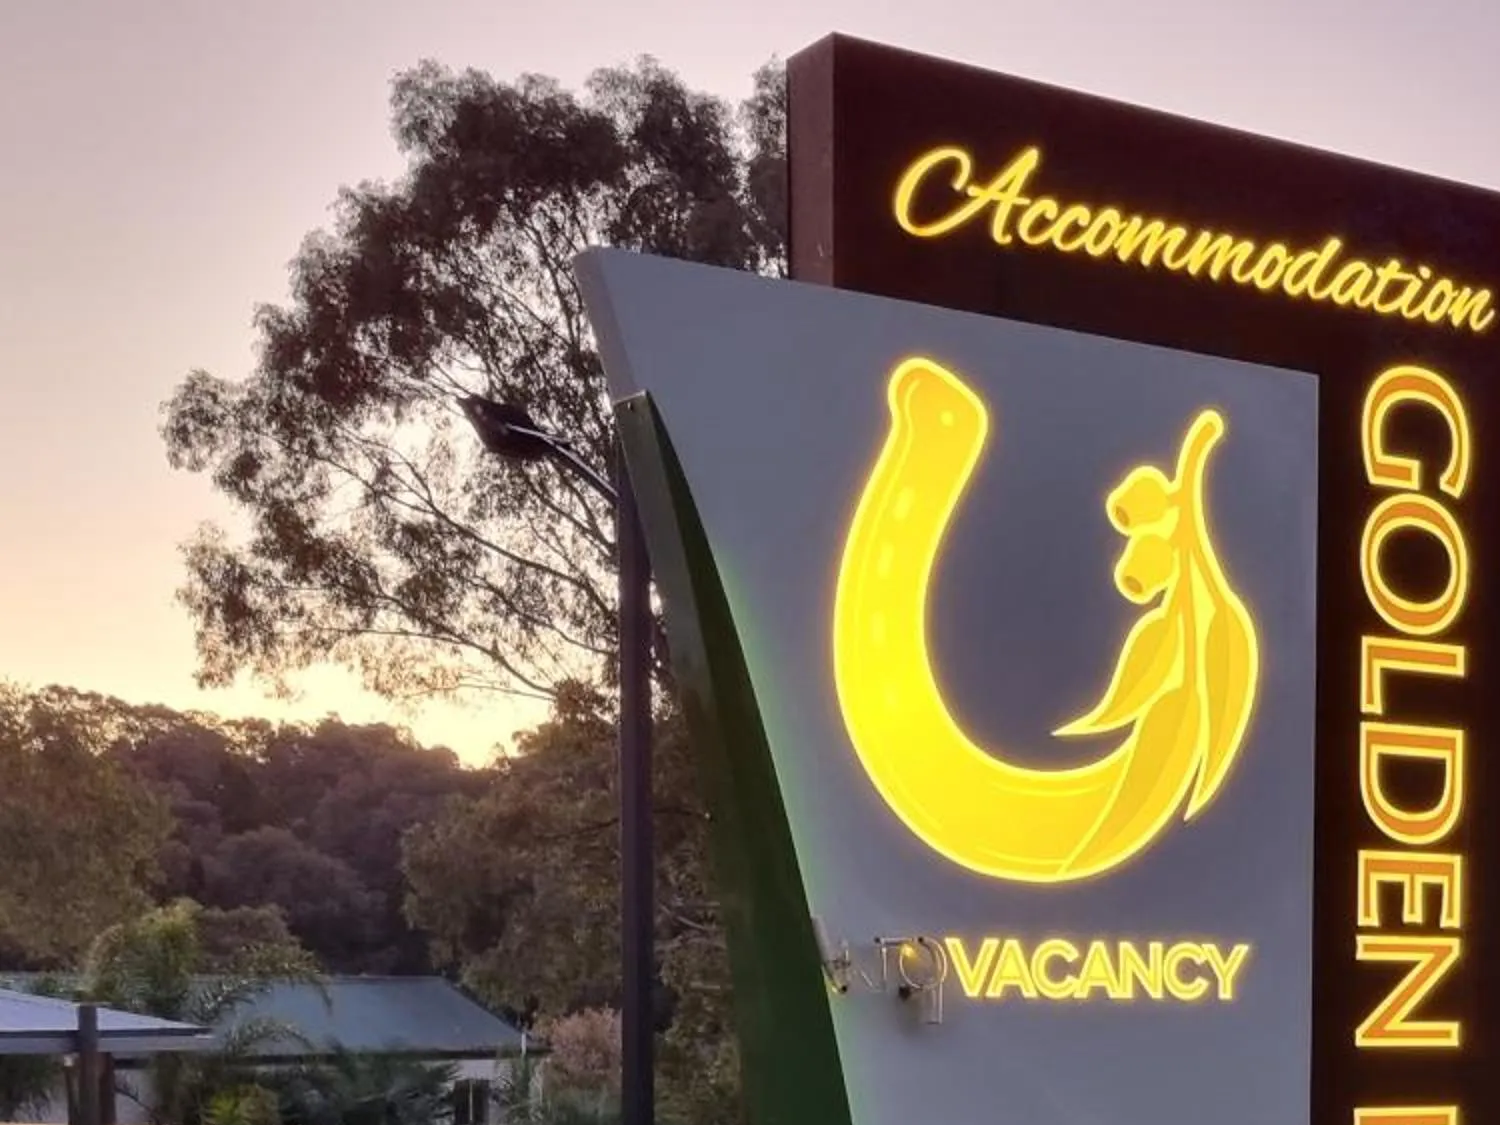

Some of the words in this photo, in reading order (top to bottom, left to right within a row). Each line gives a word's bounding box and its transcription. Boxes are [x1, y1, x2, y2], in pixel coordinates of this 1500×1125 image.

[896, 147, 1494, 331] Accommodation
[1355, 365, 1470, 1048] GOLDEN
[944, 937, 1248, 999] VACANCY
